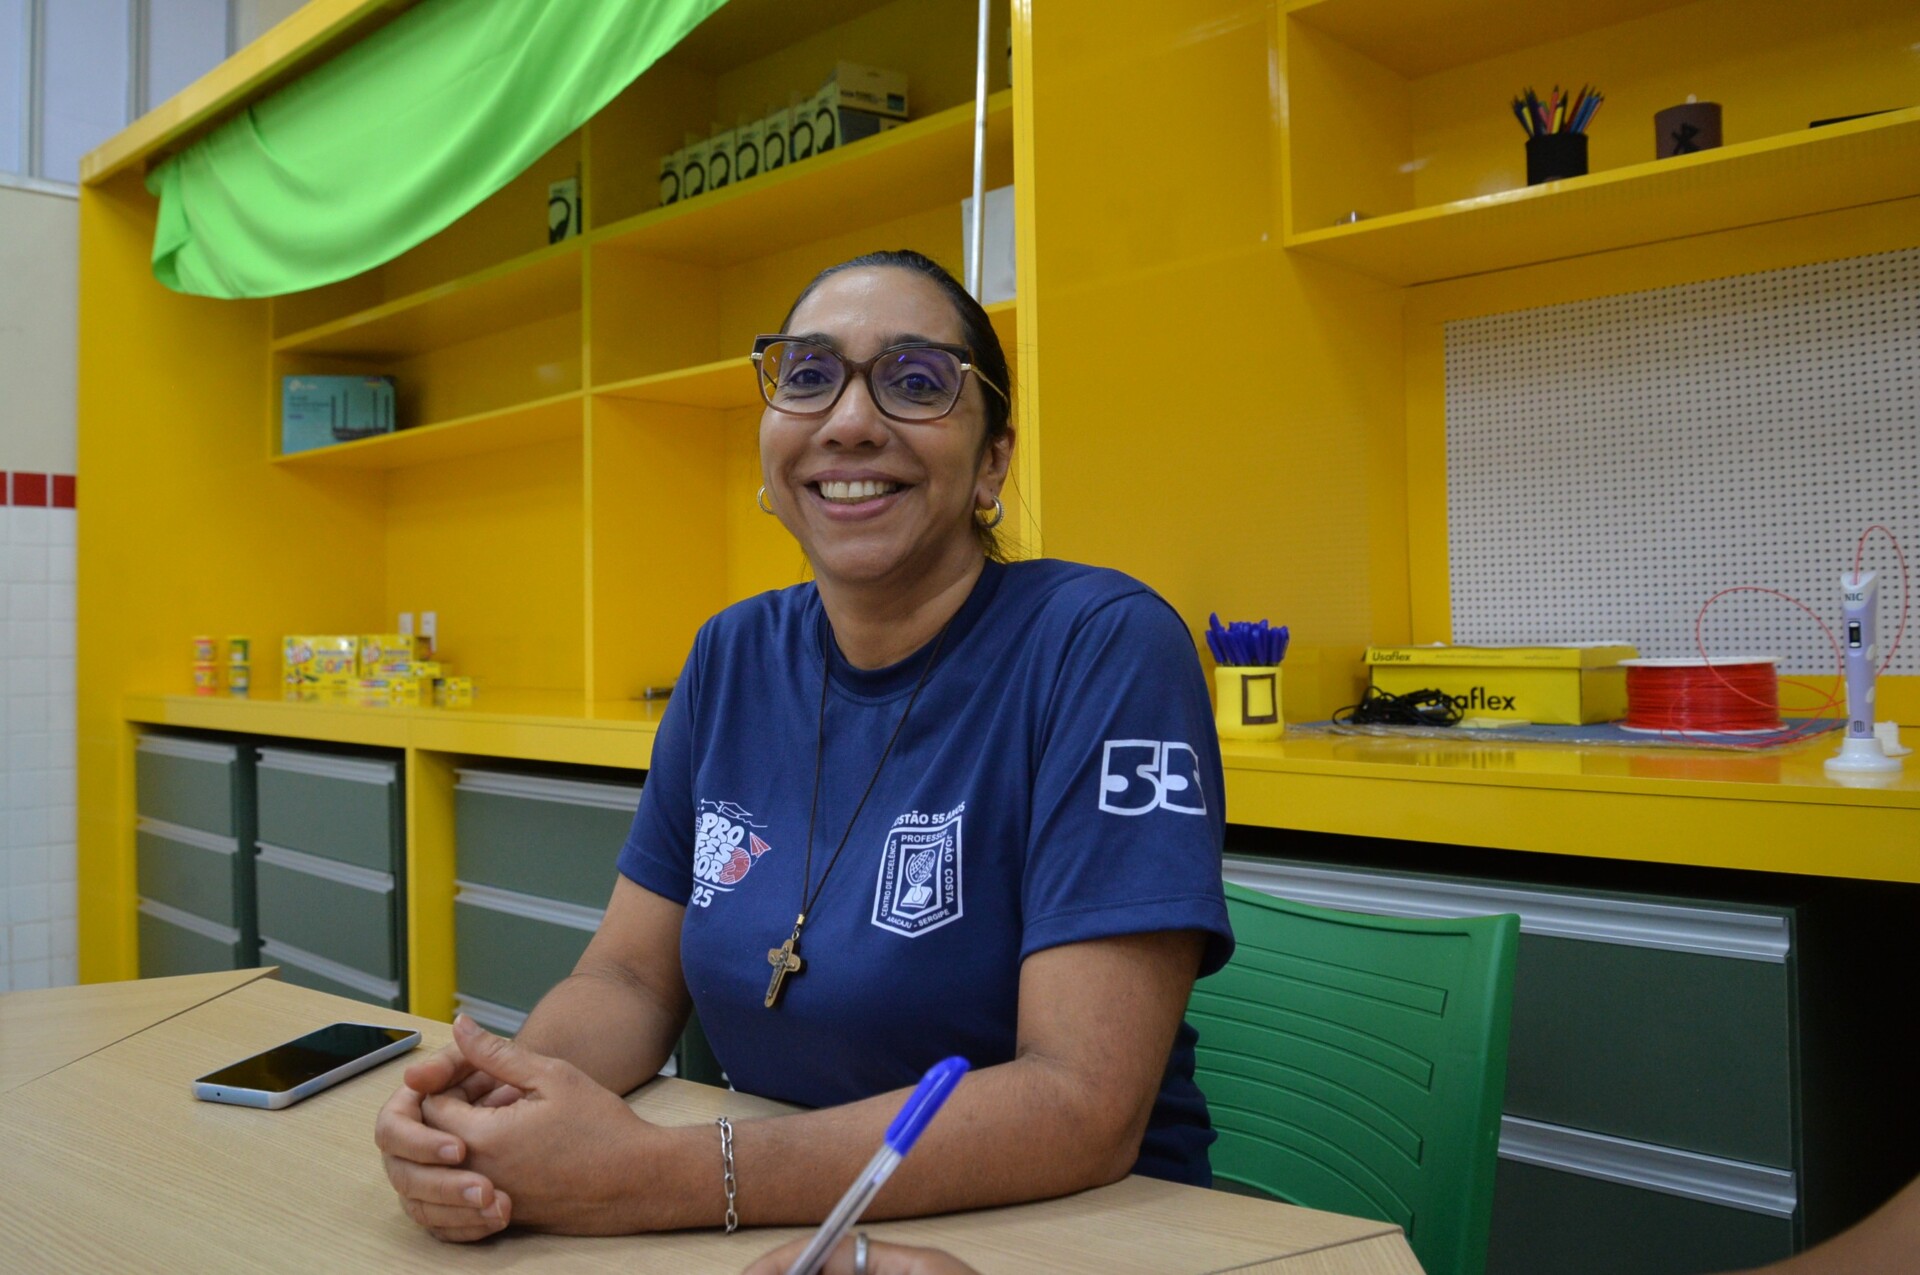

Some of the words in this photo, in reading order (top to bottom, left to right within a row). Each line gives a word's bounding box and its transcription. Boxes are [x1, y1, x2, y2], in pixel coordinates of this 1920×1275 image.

[1372, 651, 1411, 661] Usaflex
[700, 812, 745, 847] PRO
[931, 813, 946, 825] 55
[901, 829, 948, 843] PROFESSOR
[886, 839, 897, 880] EXCELÊNCIA
[944, 835, 955, 863] JOÃO
[885, 880, 894, 890] DE
[944, 868, 955, 904] COSTA
[881, 890, 892, 917] CENTRO
[918, 908, 951, 927] SERGIPE
